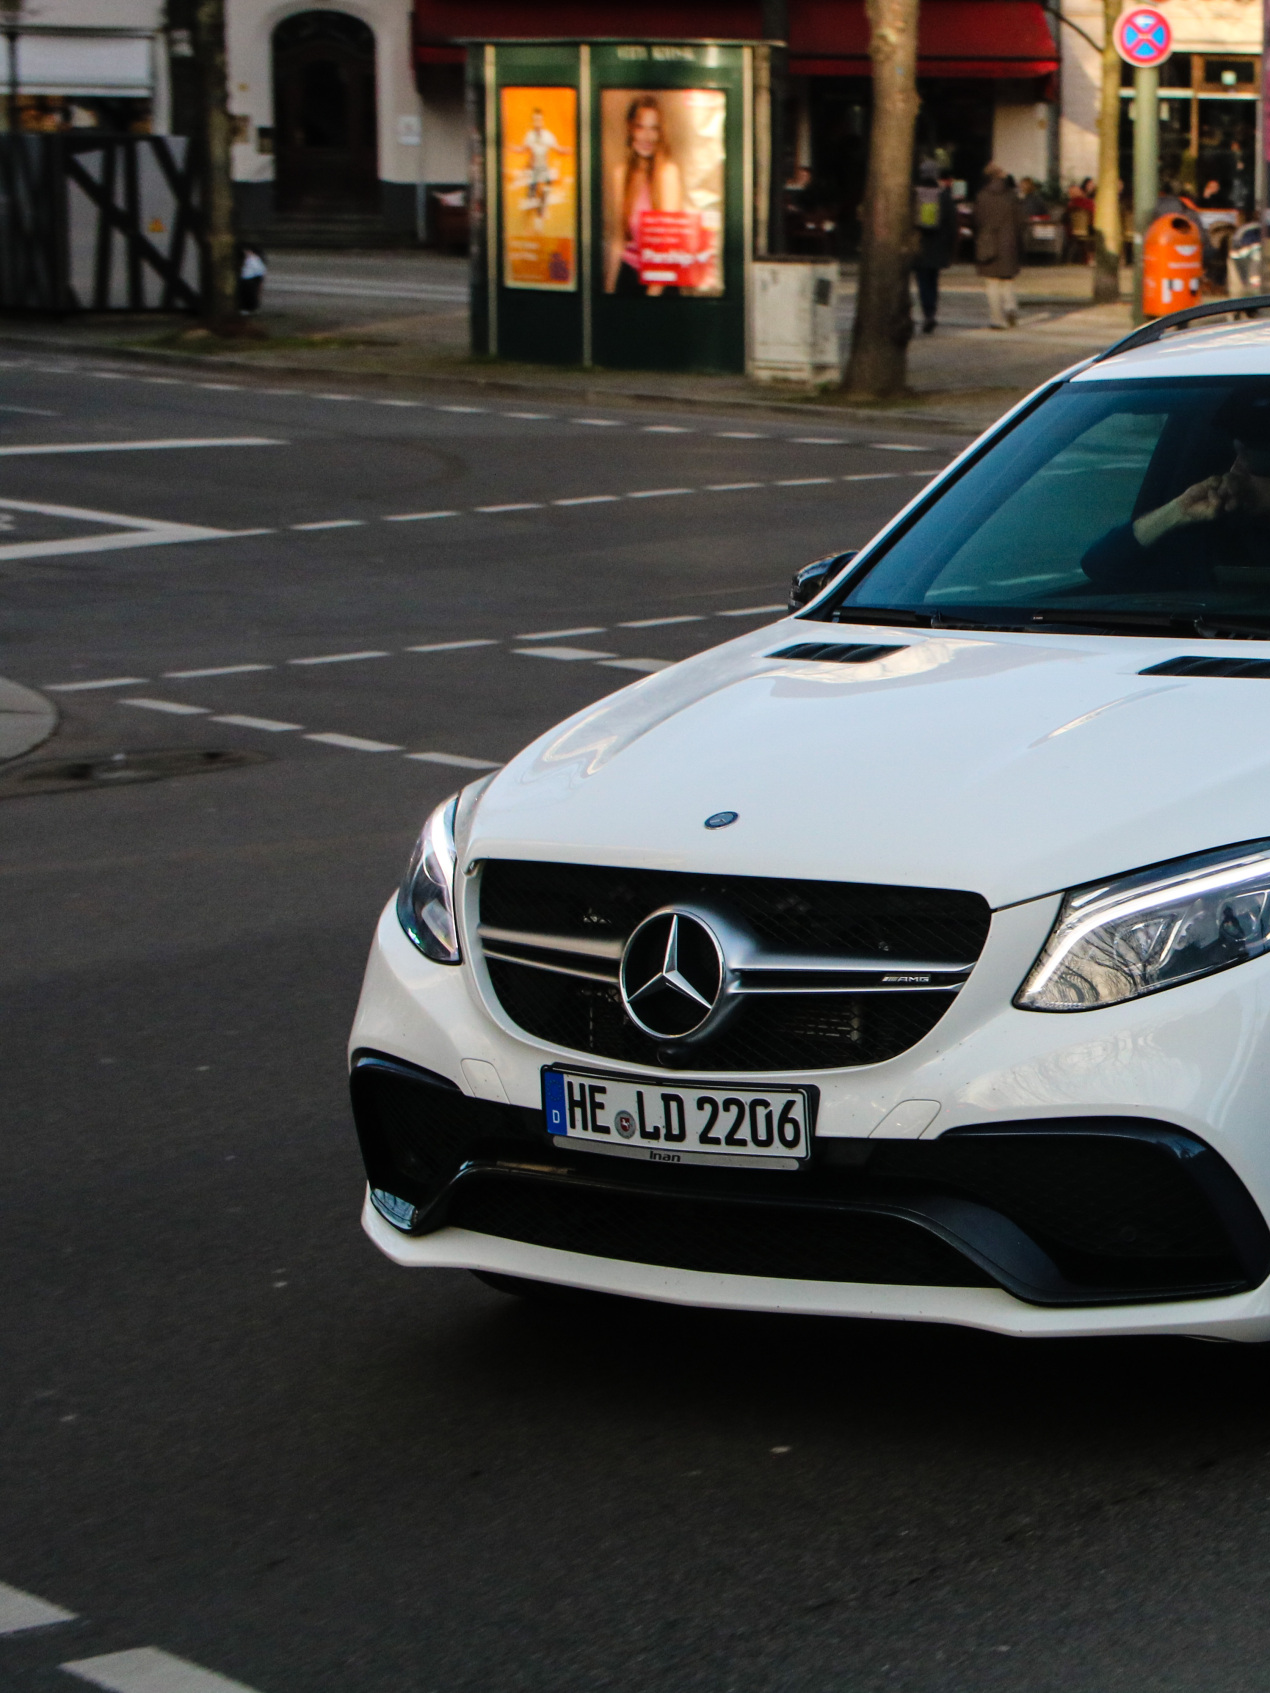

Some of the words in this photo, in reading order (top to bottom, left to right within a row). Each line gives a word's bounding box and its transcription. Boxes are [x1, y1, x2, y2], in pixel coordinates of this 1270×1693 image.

[552, 1109, 560, 1124] D
[567, 1081, 611, 1135] HE
[636, 1090, 687, 1142] LD
[696, 1095, 801, 1149] 2206
